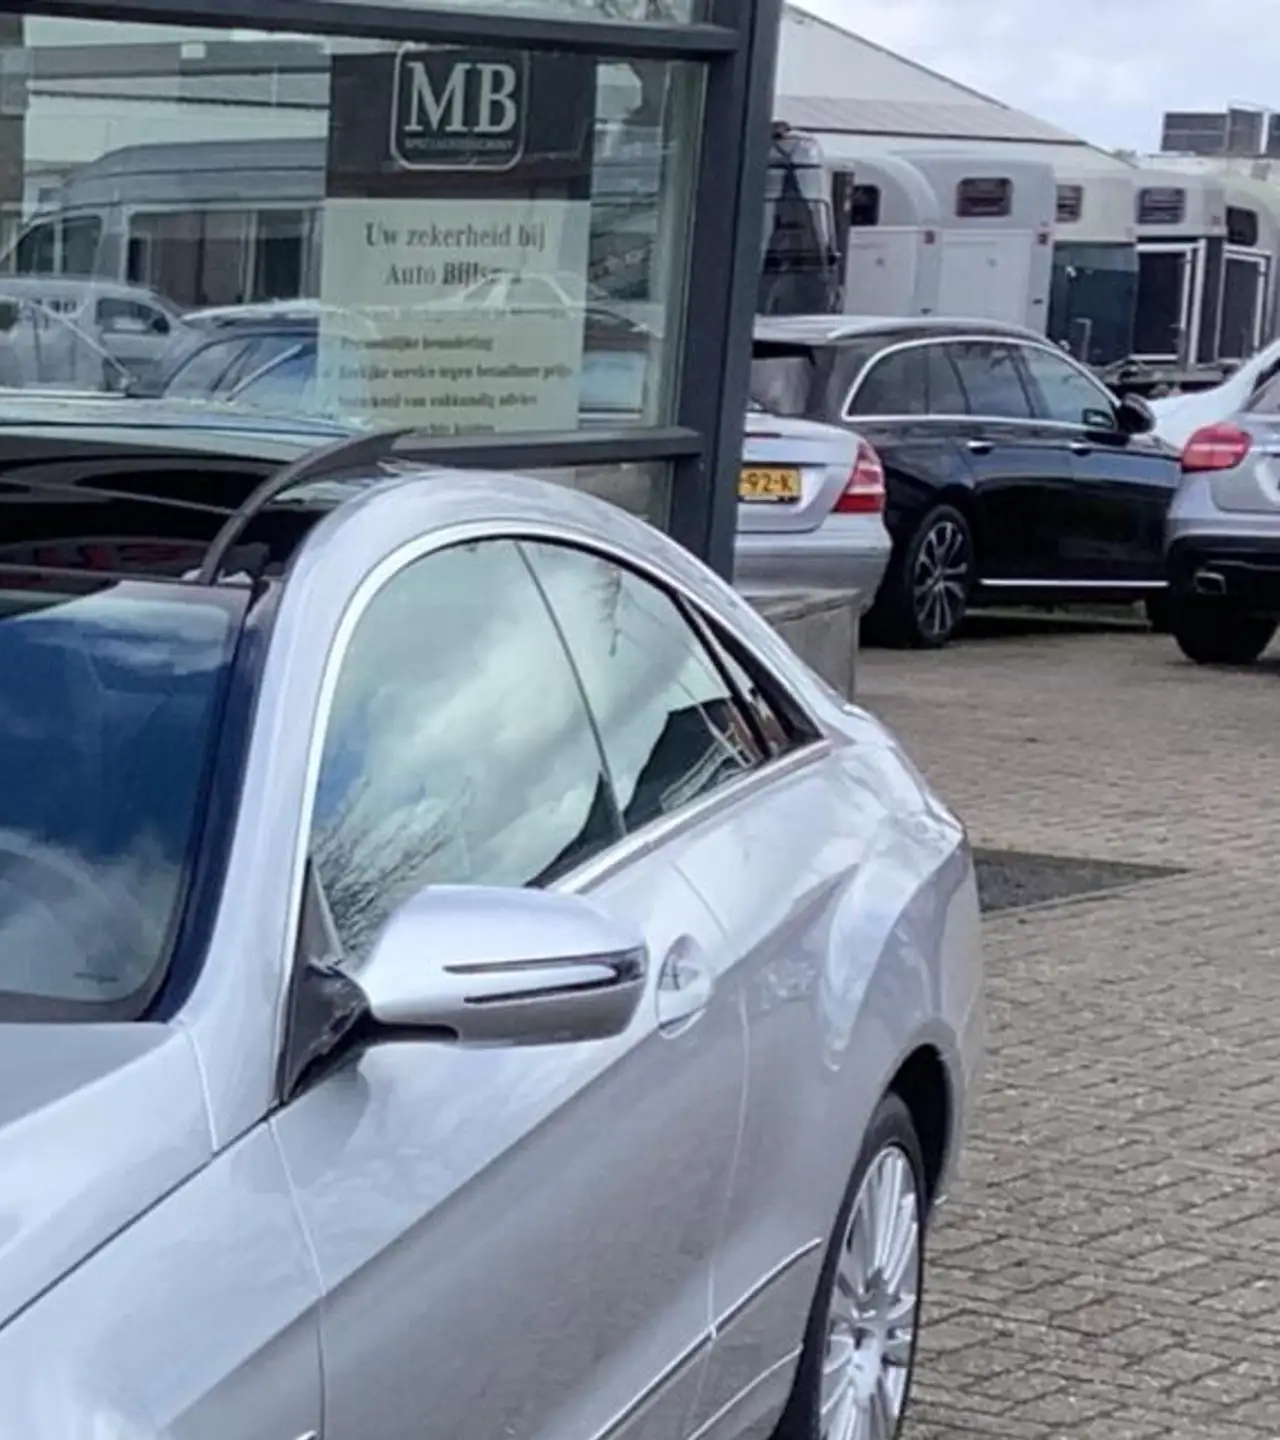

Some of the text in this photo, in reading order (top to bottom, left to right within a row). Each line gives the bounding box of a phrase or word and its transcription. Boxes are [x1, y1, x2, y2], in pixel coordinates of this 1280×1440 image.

[403, 61, 517, 132] MB
[365, 222, 546, 252] Uw zekerheid bij
[384, 262, 436, 286] Auto
